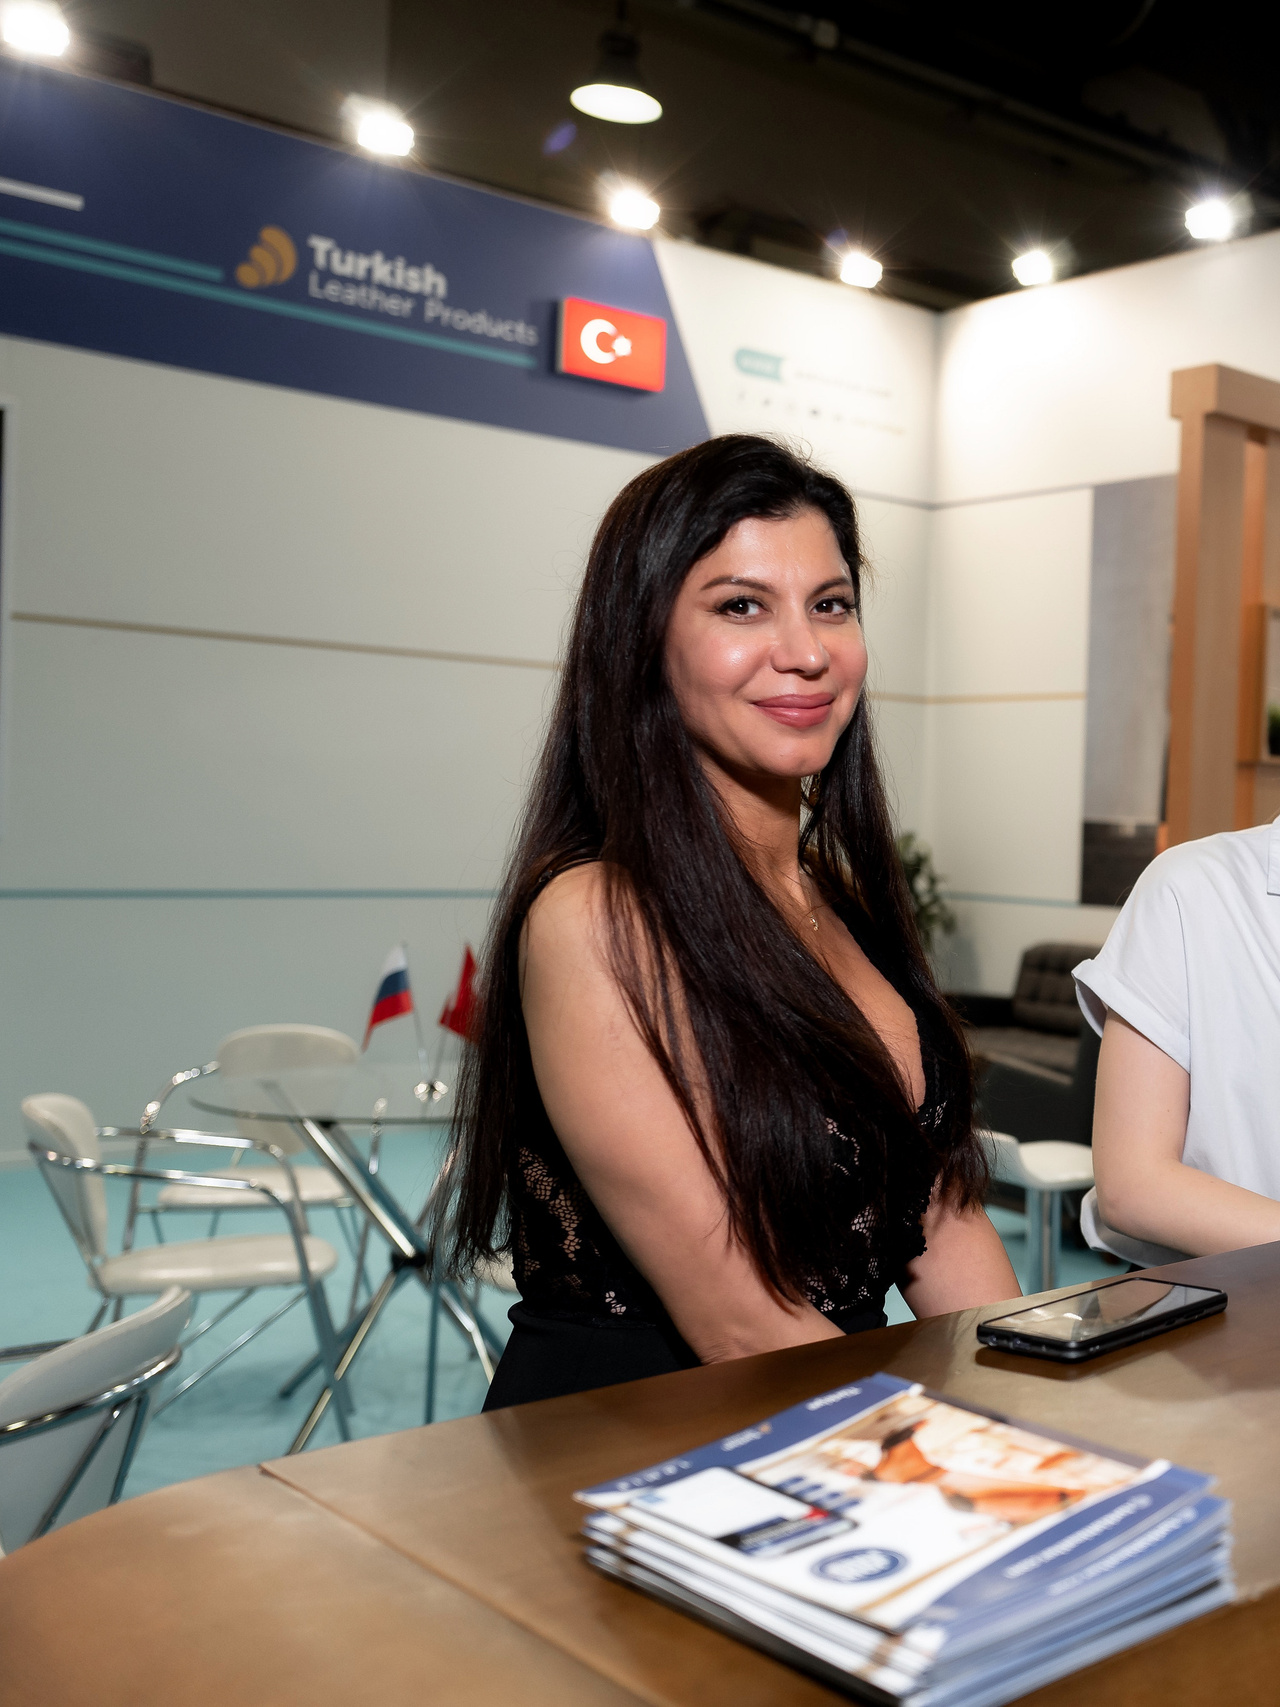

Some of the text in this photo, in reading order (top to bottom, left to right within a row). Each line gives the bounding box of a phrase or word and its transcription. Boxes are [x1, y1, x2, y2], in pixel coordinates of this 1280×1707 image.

[308, 235, 447, 299] Turkish
[308, 270, 538, 346] Leather Products
